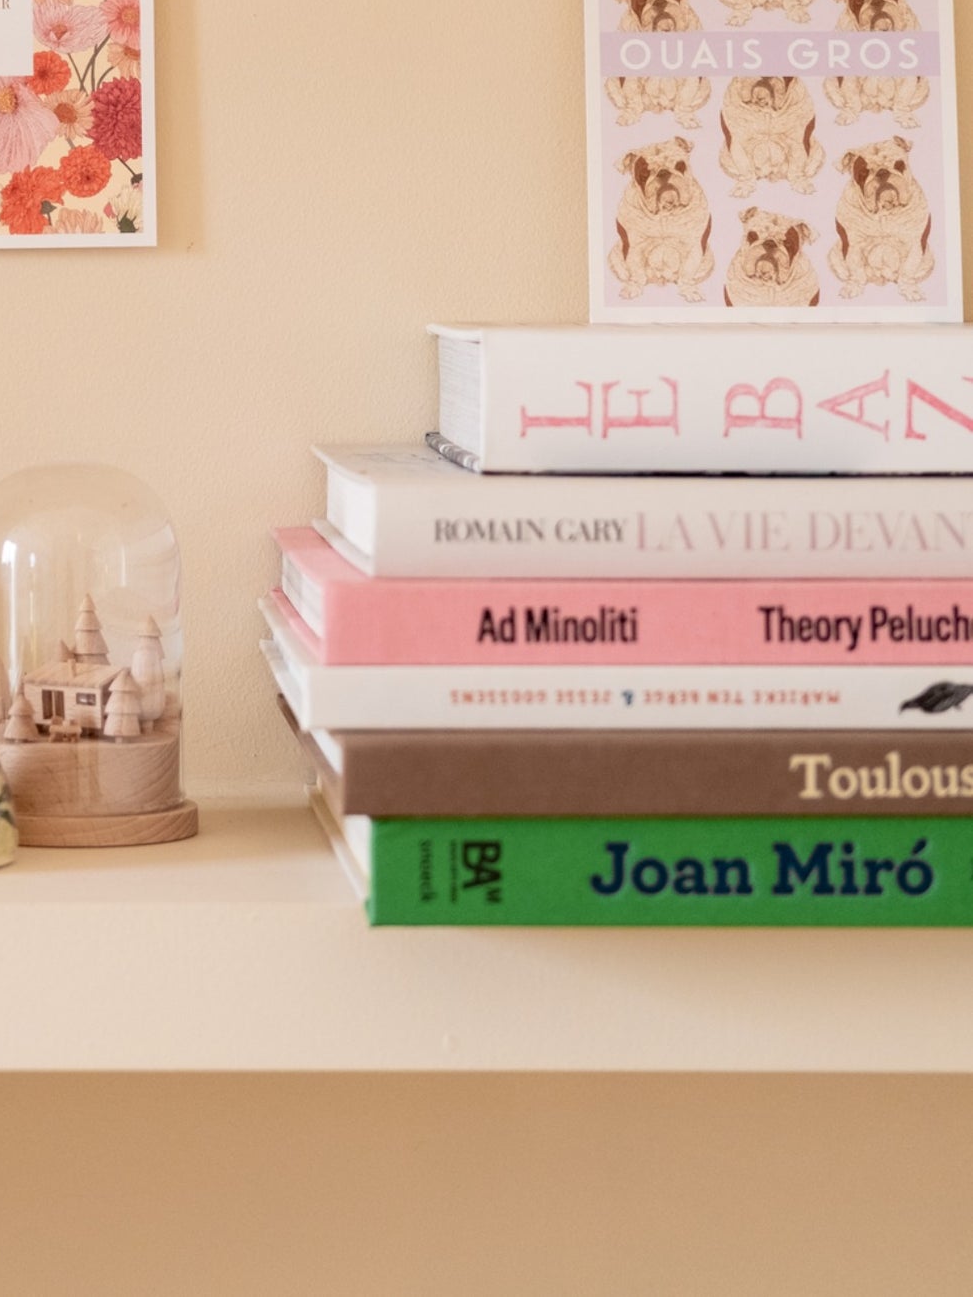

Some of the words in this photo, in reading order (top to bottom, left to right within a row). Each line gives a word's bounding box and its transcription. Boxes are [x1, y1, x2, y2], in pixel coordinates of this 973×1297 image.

[619, 38, 763, 70] OUAIS
[787, 38, 919, 70] GROS
[434, 517, 546, 543] ROMAIN
[554, 517, 628, 543] GARY
[636, 511, 695, 552] LA
[706, 511, 791, 552] VIE
[807, 511, 973, 552] DEVAN
[477, 606, 517, 643] Ad
[525, 605, 638, 643] Minoliti
[757, 605, 863, 652] Theory
[870, 604, 973, 642] Peluch
[590, 841, 754, 896] Joan
[771, 837, 934, 896] Miró
